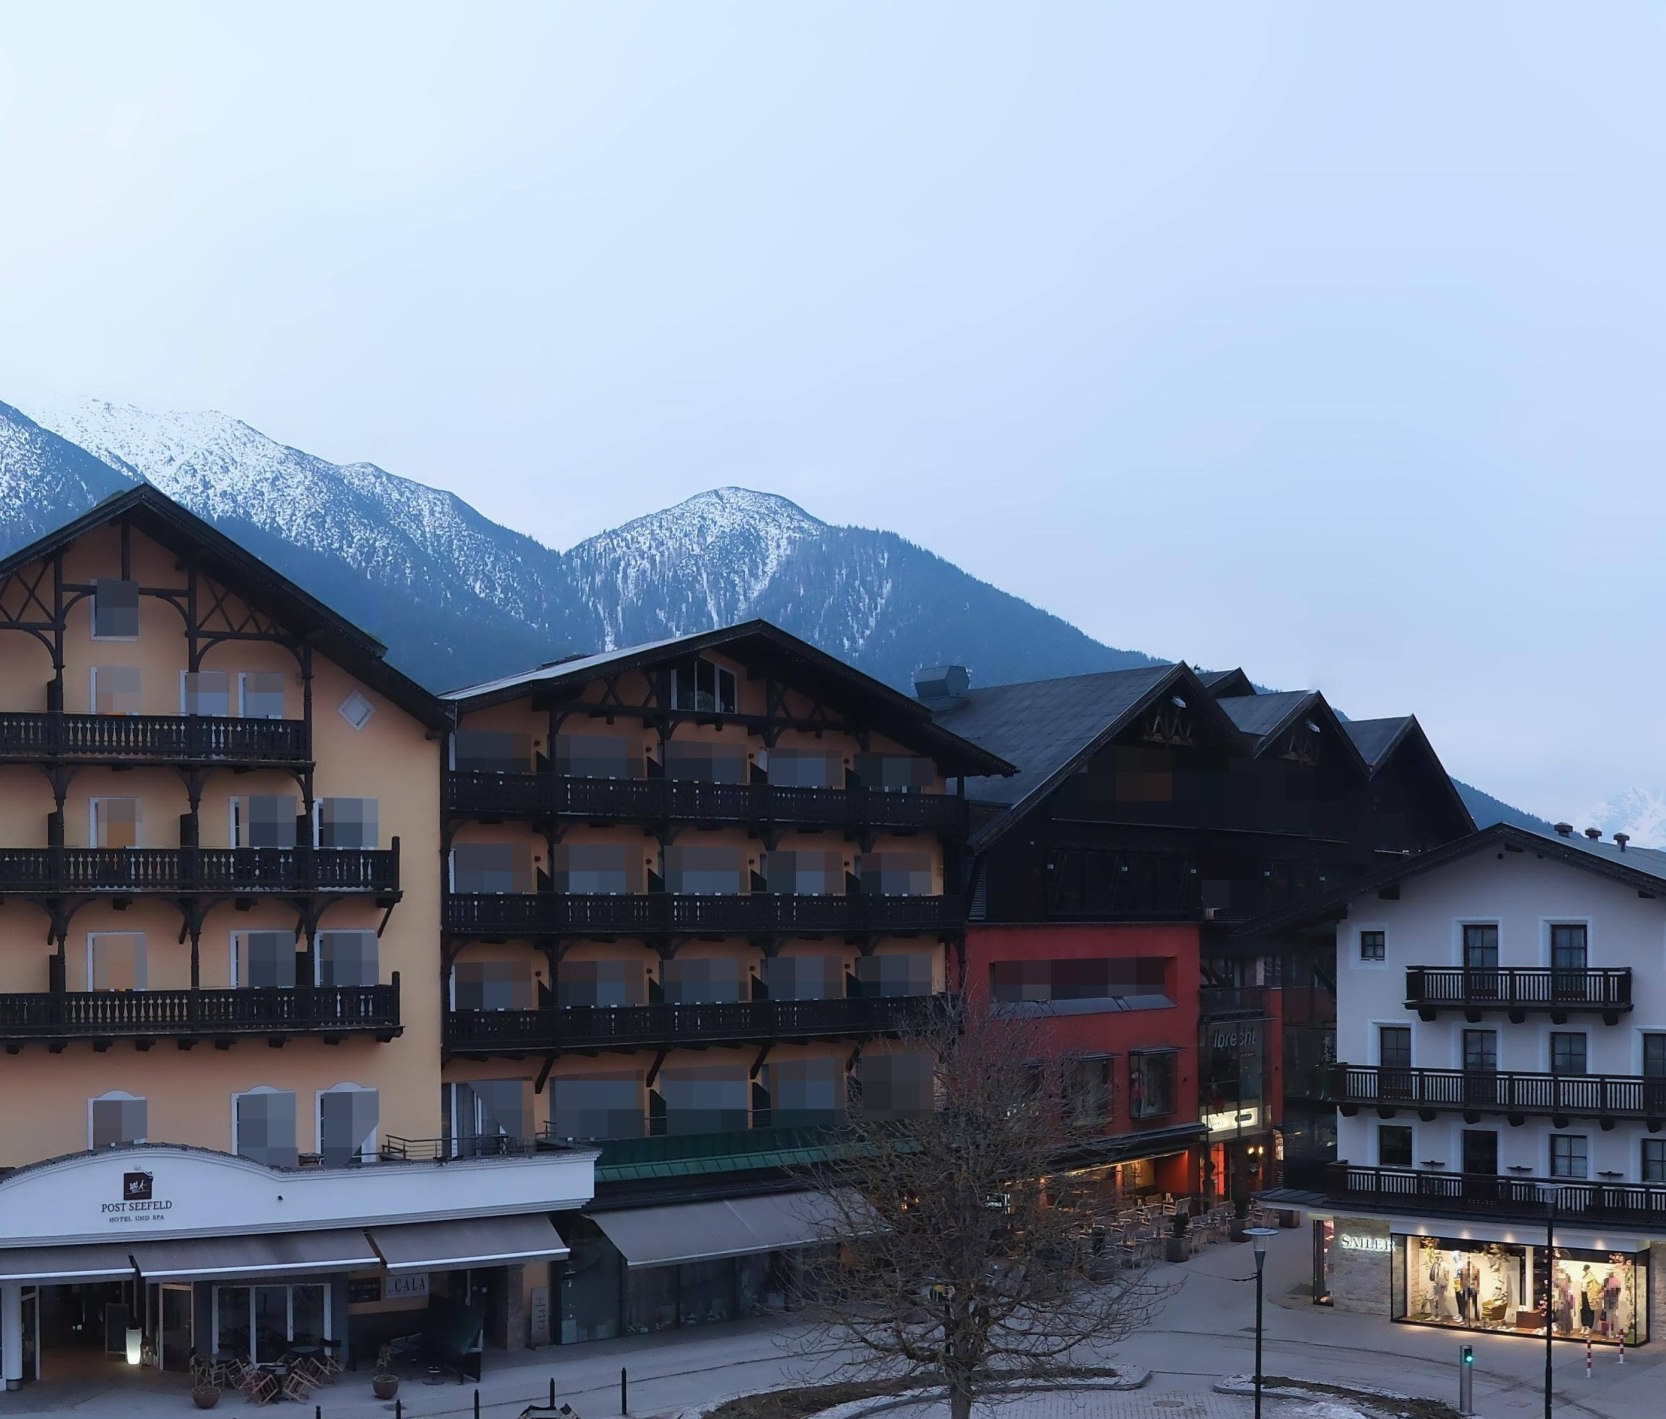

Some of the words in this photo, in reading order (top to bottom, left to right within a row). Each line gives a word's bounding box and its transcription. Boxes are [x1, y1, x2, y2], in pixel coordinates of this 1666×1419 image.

[102, 1202, 126, 1213] POST
[129, 1200, 172, 1211] SEEFELD
[1341, 1234, 1395, 1252] SAILER
[394, 1277, 426, 1293] CALA
